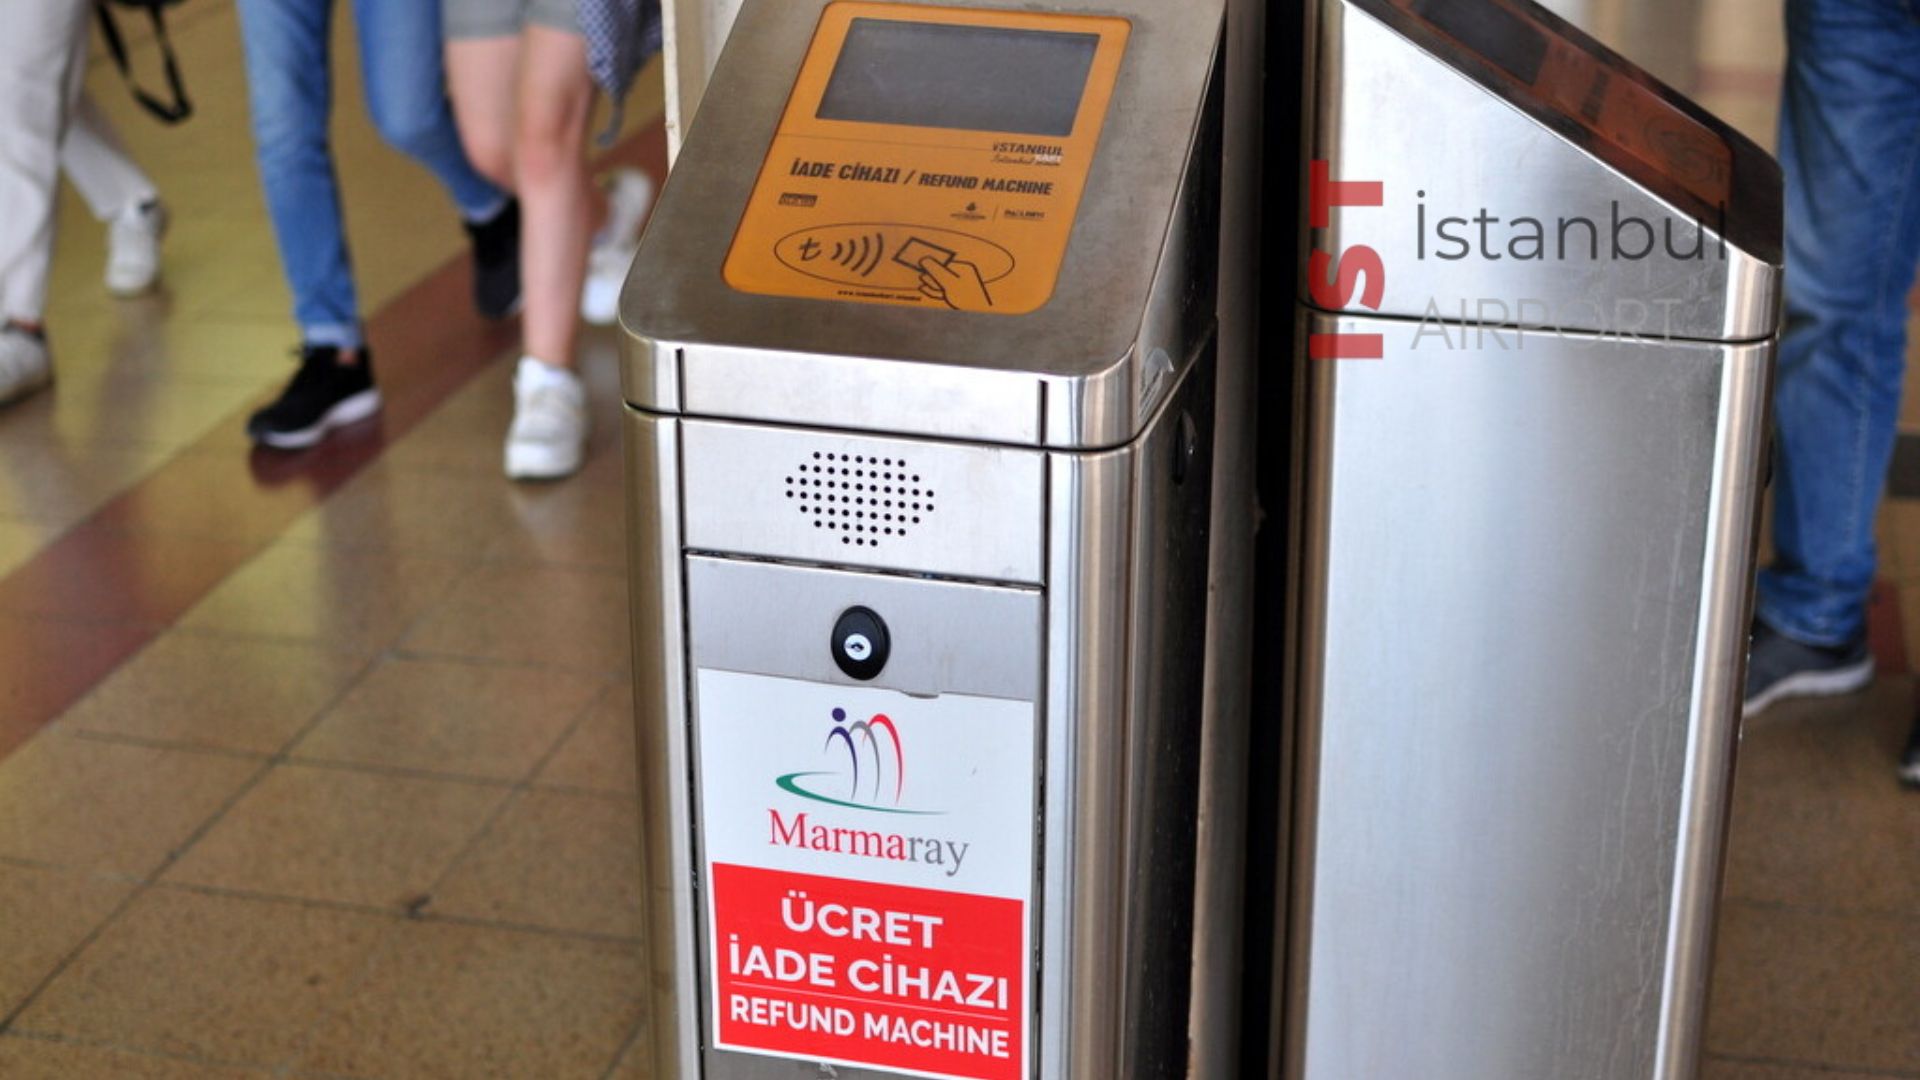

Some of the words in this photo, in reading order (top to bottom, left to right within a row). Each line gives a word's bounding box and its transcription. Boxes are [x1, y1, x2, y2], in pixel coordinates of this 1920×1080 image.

[790, 158, 835, 178] İADE
[838, 162, 900, 183] CİHAZI
[918, 173, 978, 190] REFUND
[981, 178, 1054, 195] MACHINE
[767, 808, 970, 877] Marmaray
[781, 890, 943, 949] ÜCRET
[729, 933, 836, 987] İADE
[847, 954, 1008, 1011] CİHAZI
[730, 994, 856, 1037] REFUND
[863, 1013, 1010, 1058] MACHINE
